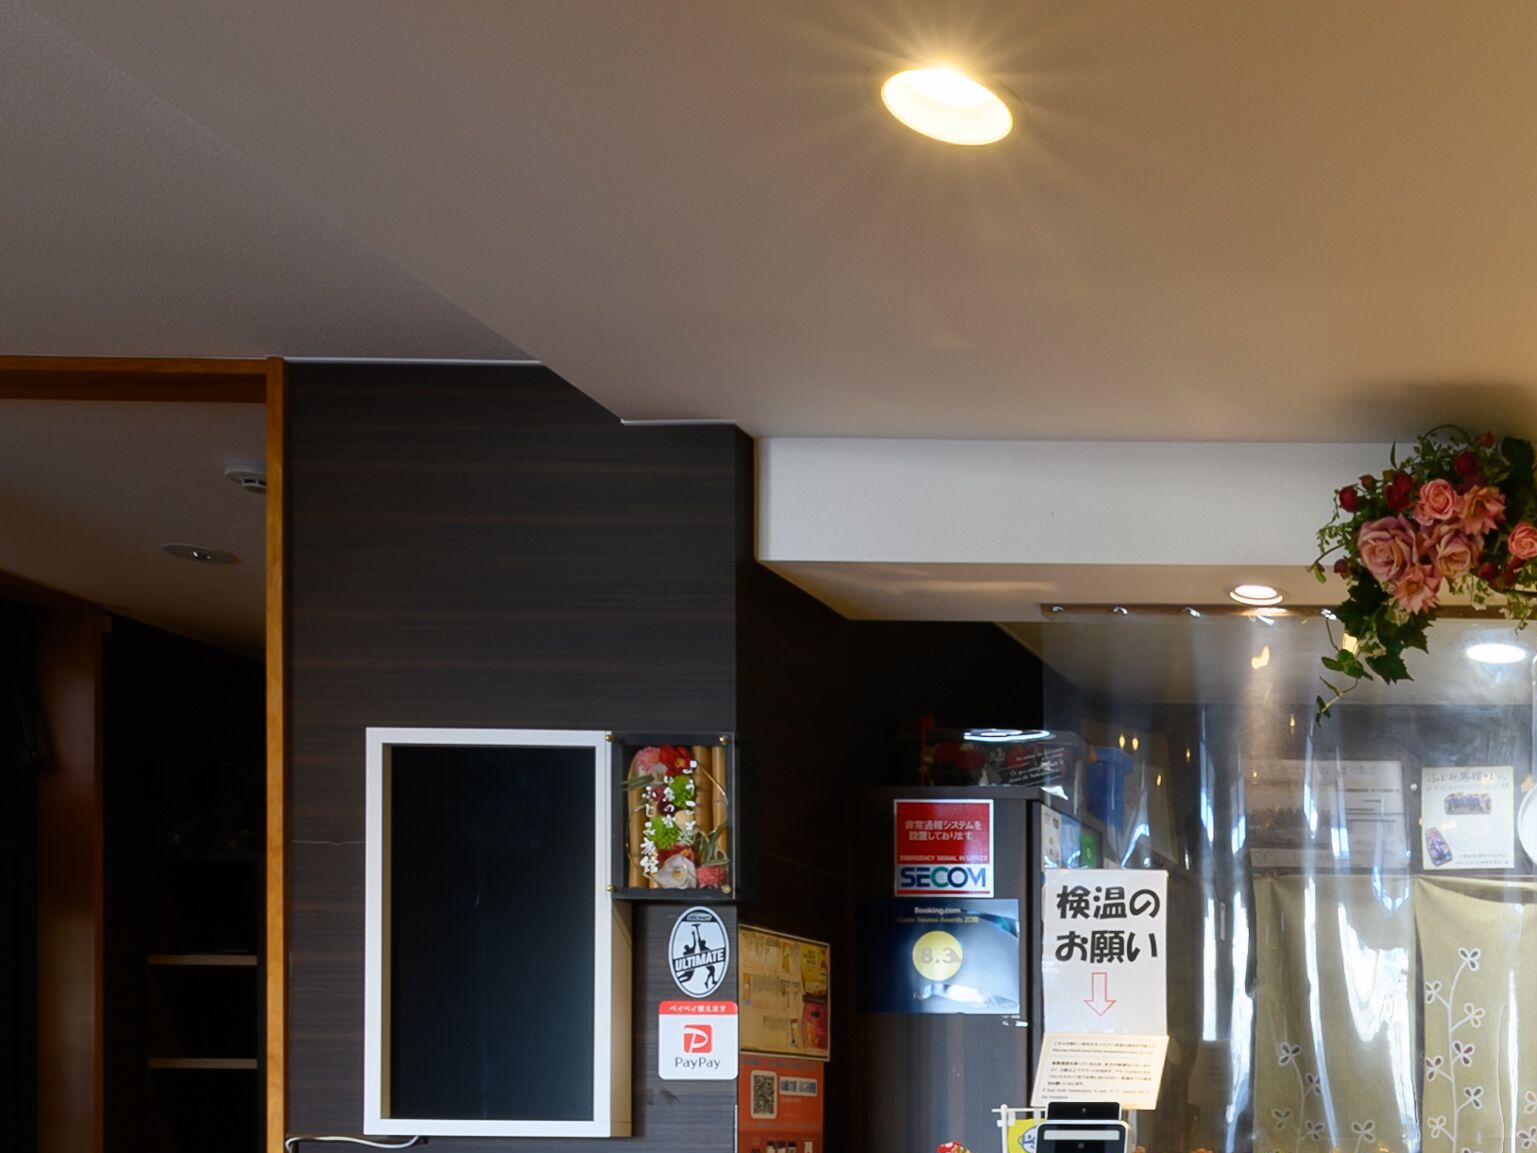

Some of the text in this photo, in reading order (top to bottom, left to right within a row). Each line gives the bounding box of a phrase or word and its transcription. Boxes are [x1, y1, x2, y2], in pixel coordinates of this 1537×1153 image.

[901, 866, 986, 888] SECOM
[914, 907, 961, 915] Booking.com
[1056, 885, 1161, 920] 検温の
[1055, 930, 1158, 964] お願い
[674, 948, 726, 972] ULTIMATE
[669, 1004, 727, 1013] ペイペイ使えます
[675, 1057, 721, 1069] PayPay
